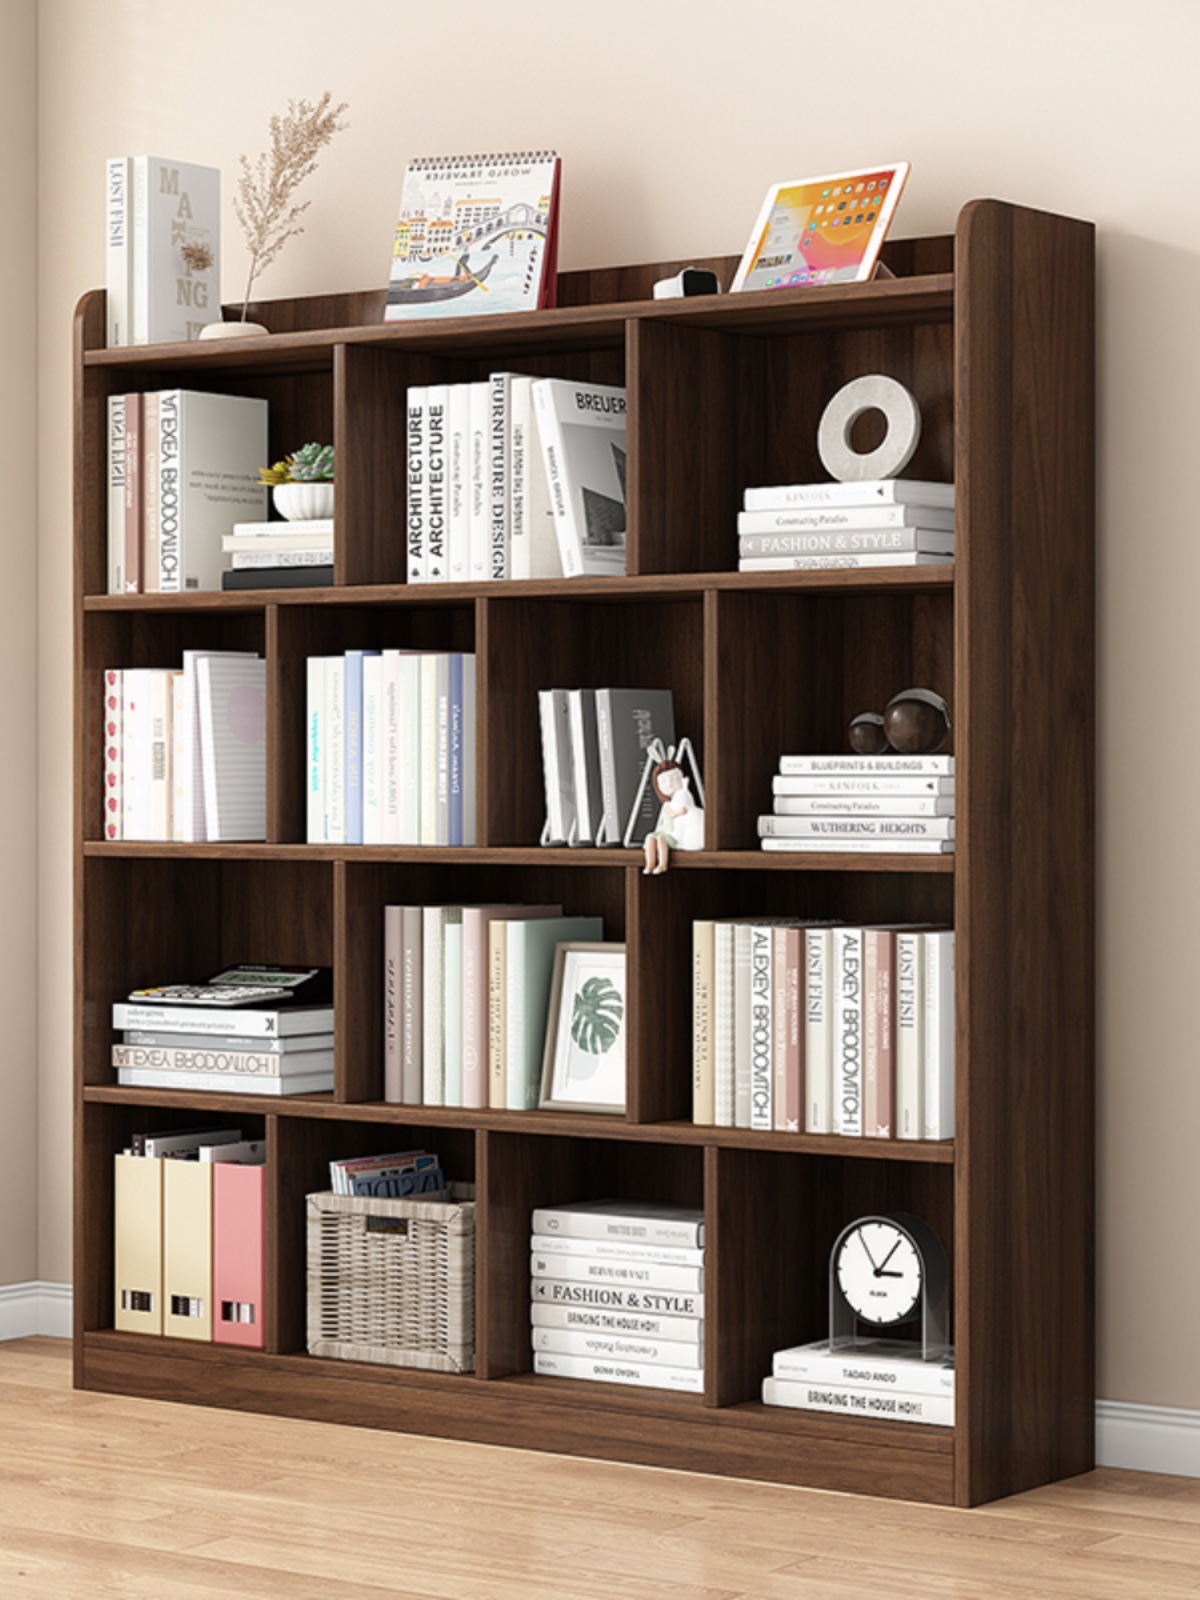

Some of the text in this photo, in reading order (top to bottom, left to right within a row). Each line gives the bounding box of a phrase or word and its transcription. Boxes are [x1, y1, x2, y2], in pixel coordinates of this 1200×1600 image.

[110, 163, 124, 247] LOST FISH
[408, 406, 422, 558] ARCHITECTURE
[429, 405, 444, 557] ARCHITECTURE
[492, 377, 504, 579] FURNITURE DESIGN
[761, 532, 902, 552] FASHION & STYLE
[811, 761, 865, 770] BLUEPRINTS
[875, 761, 923, 770] BUILDINGS
[811, 821, 927, 834] WUTHERING HEIGHTS
[809, 935, 822, 1023] LOST FISH
[901, 939, 914, 1028] LOST FISH
[753, 931, 769, 1119] ALEXEY BRODOVITCH
[843, 934, 859, 1124] ALEXEY BRODOVITCH
[553, 1285, 694, 1313] FASHION & STYLE
[602, 1317, 615, 1328] THE
[616, 1318, 640, 1331] HOUSE
[808, 1390, 848, 1407] BRINGING
[849, 1394, 866, 1409] THE
[868, 1397, 896, 1413] HOUSE
[842, 1369, 897, 1383] TADAO ANDO
